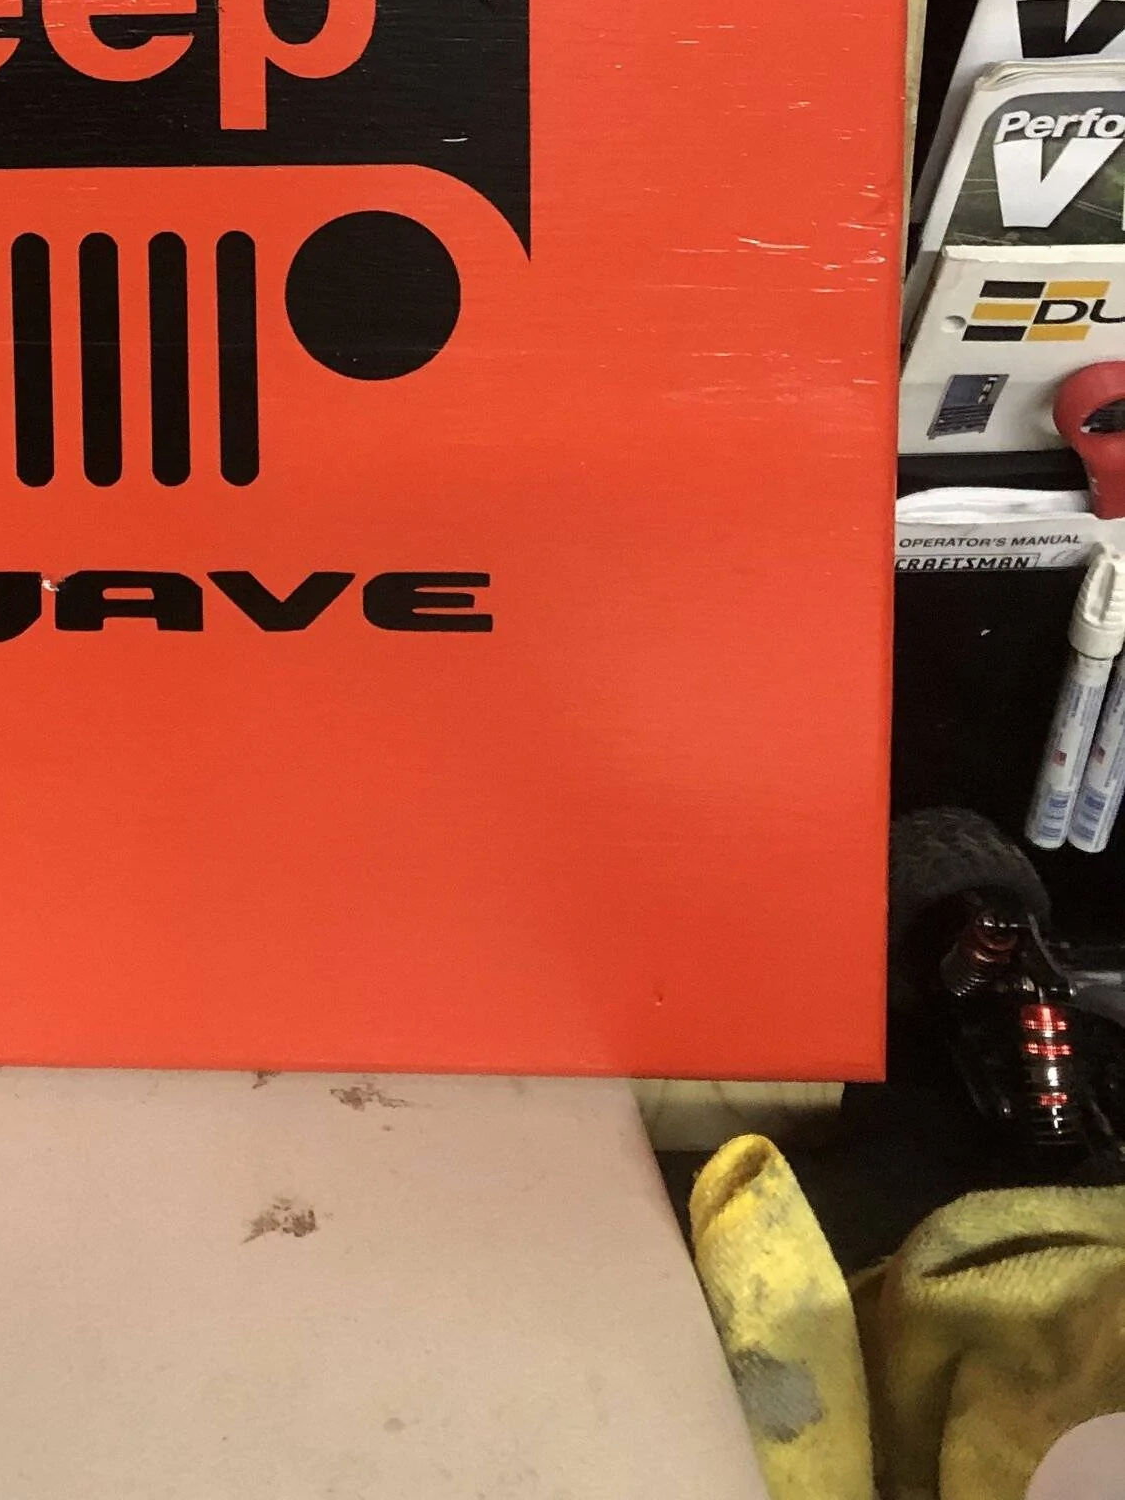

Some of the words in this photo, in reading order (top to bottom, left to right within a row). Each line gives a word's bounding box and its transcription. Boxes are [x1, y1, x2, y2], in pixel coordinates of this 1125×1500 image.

[898, 537, 1007, 548] OPERATOR'S
[1011, 534, 1081, 547] MANUAL
[894, 555, 1030, 571] CRAFTSMAN
